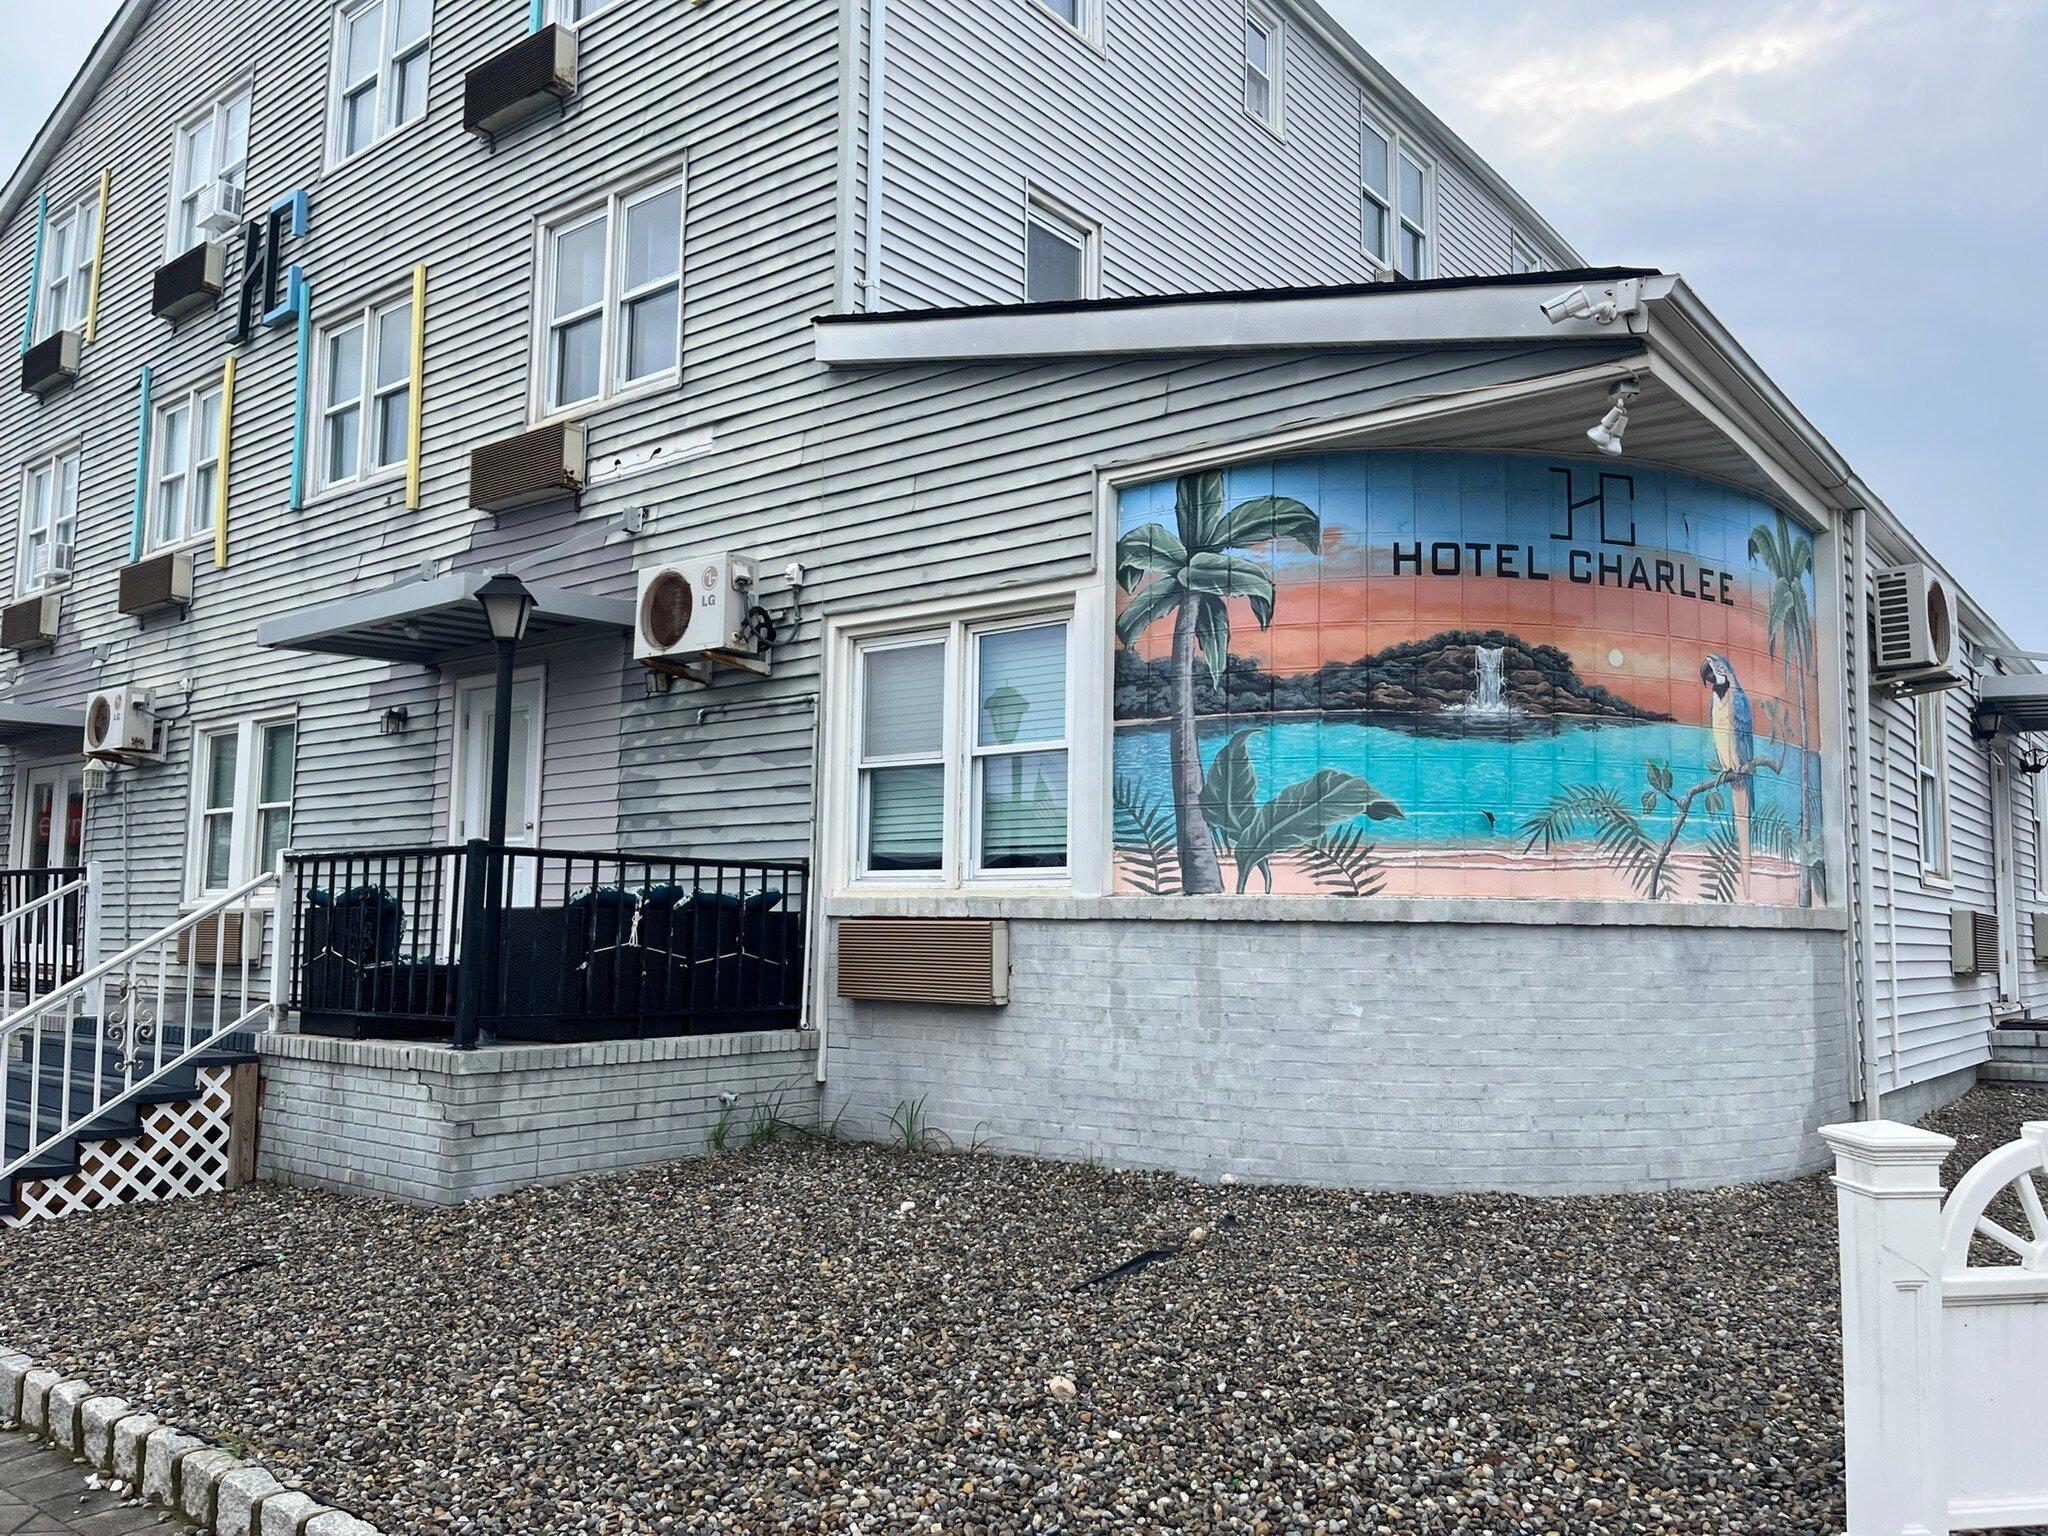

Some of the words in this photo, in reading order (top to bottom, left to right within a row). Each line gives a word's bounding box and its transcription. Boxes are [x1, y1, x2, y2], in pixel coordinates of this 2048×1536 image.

[1393, 541, 1550, 580] HOTEL
[1568, 549, 1735, 606] CHARLEE
[701, 594, 716, 607] LG
[113, 712, 121, 721] LG
